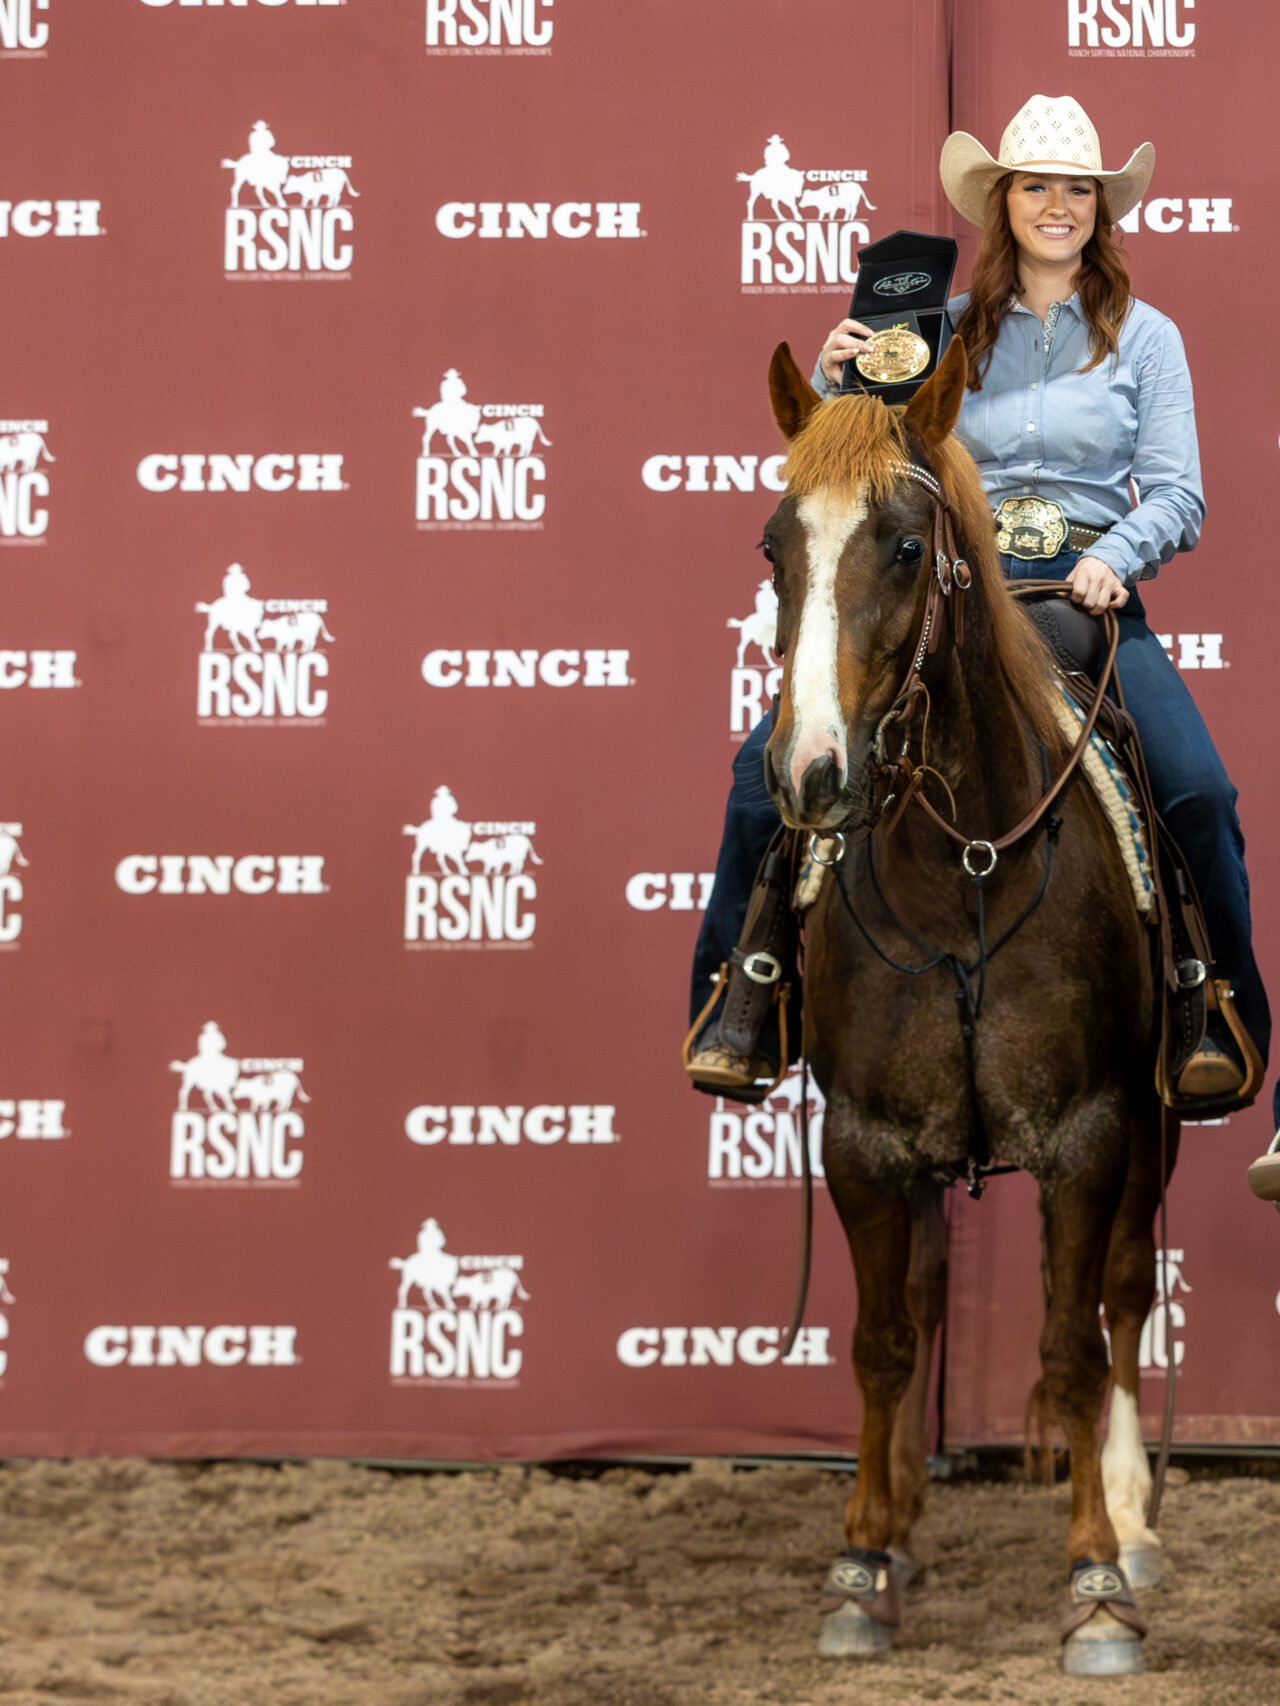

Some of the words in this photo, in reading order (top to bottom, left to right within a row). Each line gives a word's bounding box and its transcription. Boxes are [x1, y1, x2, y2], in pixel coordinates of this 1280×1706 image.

[426, 0, 553, 46] RSNC
[1068, 0, 1195, 47] RSNC
[291, 156, 352, 168] CINCH
[806, 170, 868, 181] CINCH
[225, 208, 353, 271] RSNC
[436, 202, 641, 238] CINCH
[741, 222, 870, 284] RSNC
[137, 454, 344, 492] CINCH
[416, 457, 545, 520] RSNC
[641, 454, 788, 492] CINC
[198, 653, 328, 716] RSNC
[422, 649, 630, 687] CINCH
[116, 855, 325, 894] CINCH
[404, 875, 536, 940] RSNC
[170, 1112, 304, 1178] RSNC
[405, 1105, 613, 1145] CINCH
[84, 1325, 296, 1367] CINCH
[390, 1309, 523, 1378] RSNC
[616, 1326, 829, 1366] CINCH
